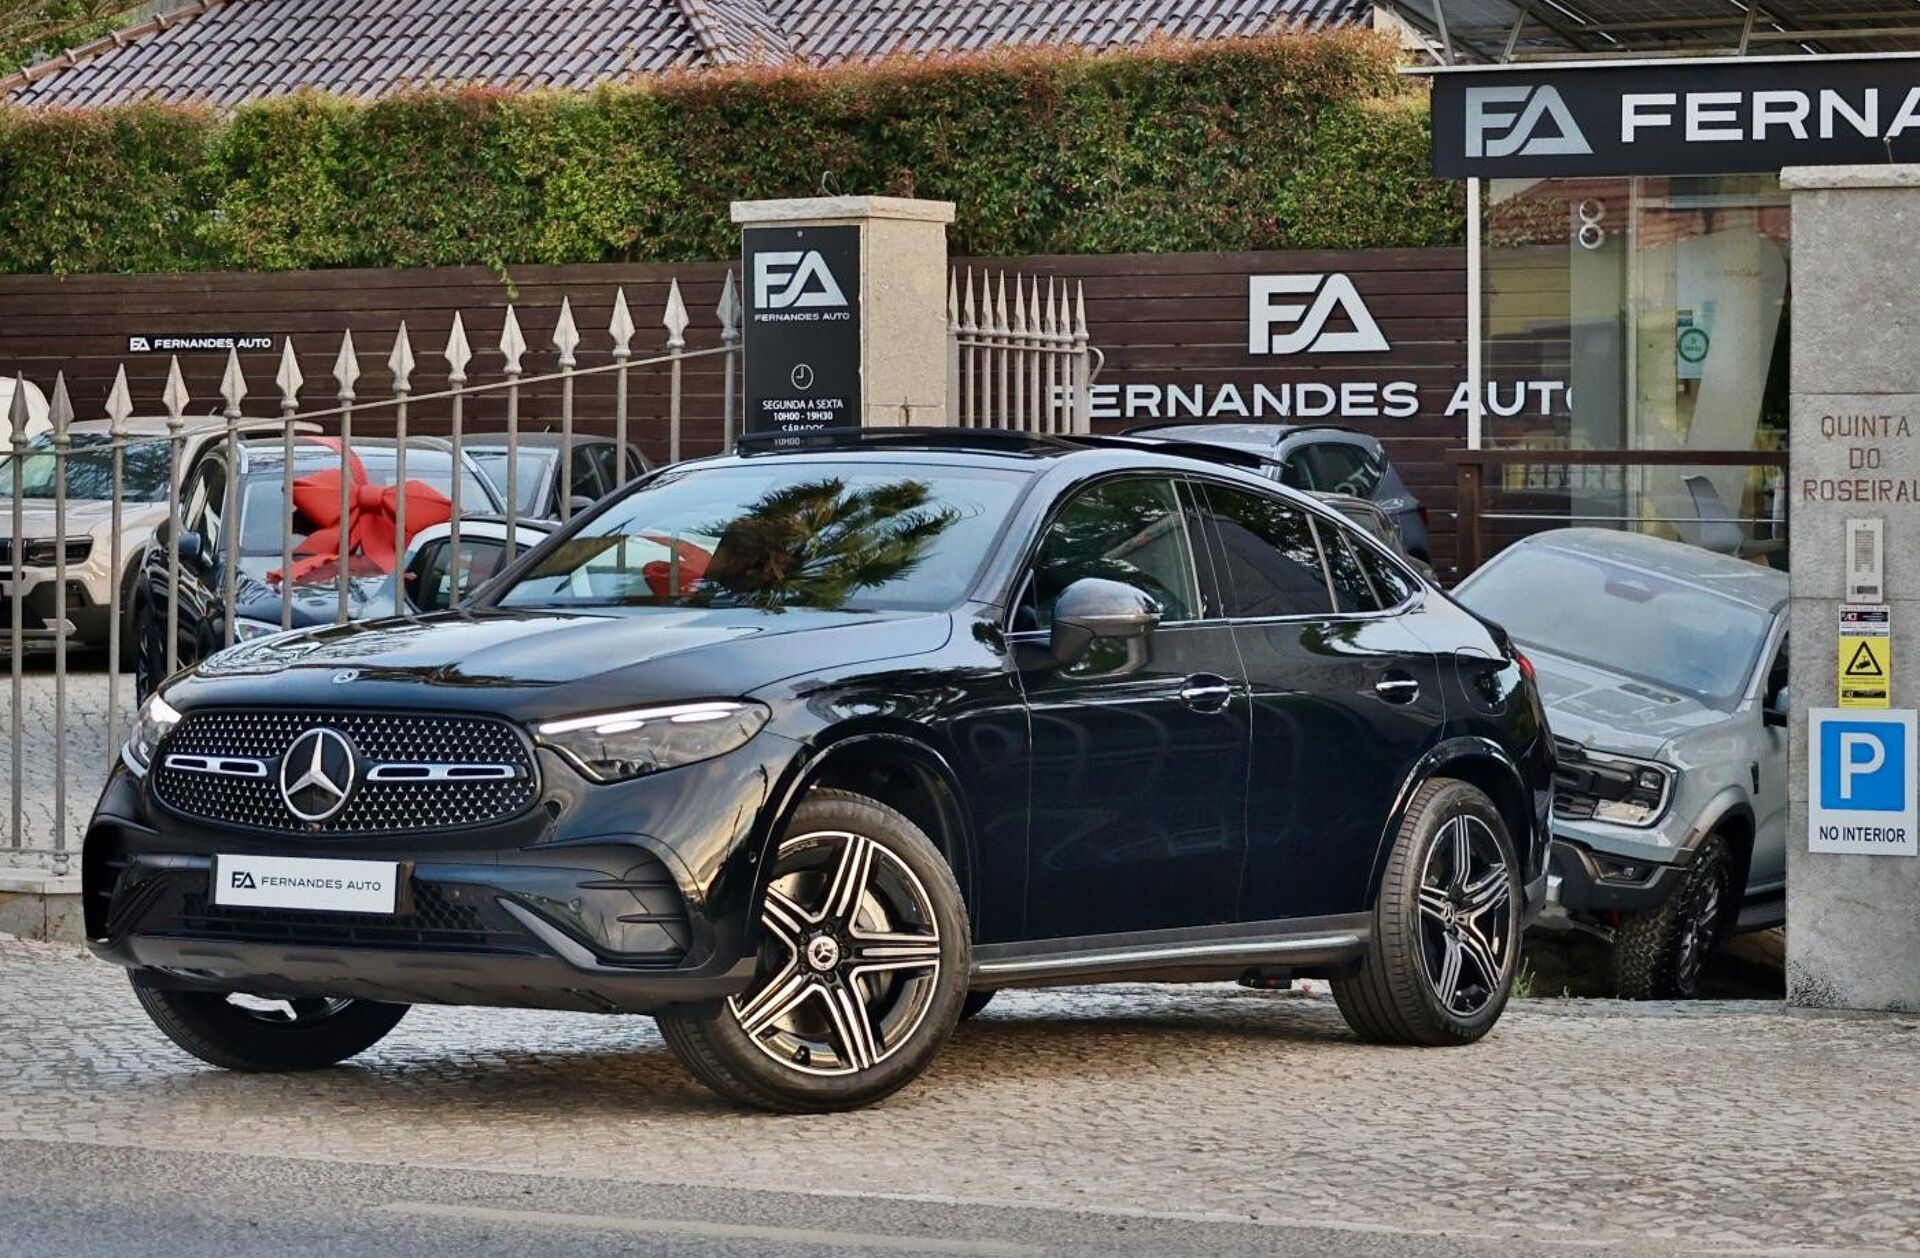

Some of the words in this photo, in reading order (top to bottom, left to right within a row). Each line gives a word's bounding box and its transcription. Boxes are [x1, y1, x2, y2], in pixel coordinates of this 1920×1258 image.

[1465, 84, 1594, 158] FA
[753, 250, 849, 309] FA
[754, 312, 820, 322] FERNANDES
[822, 312, 850, 321] AUTO
[1248, 272, 1391, 354] FA
[154, 338, 234, 349] FERNANDES
[237, 338, 272, 348] AUTO
[762, 400, 806, 410] SEGUNDA
[807, 399, 815, 409] A
[816, 398, 844, 409] SEXTA
[1443, 380, 1572, 417] AUT
[773, 411, 800, 421] 10H00
[806, 411, 833, 421] 19H30
[1820, 415, 1911, 440] QUINTA
[1850, 448, 1880, 469] DO
[1803, 479, 1920, 501] ROSEIRAL
[1839, 732, 1886, 800] P
[1819, 825, 1839, 841] NO
[1842, 826, 1906, 843] INTERIOR
[261, 876, 342, 889] FERNANDES
[346, 881, 381, 891] AUTO
